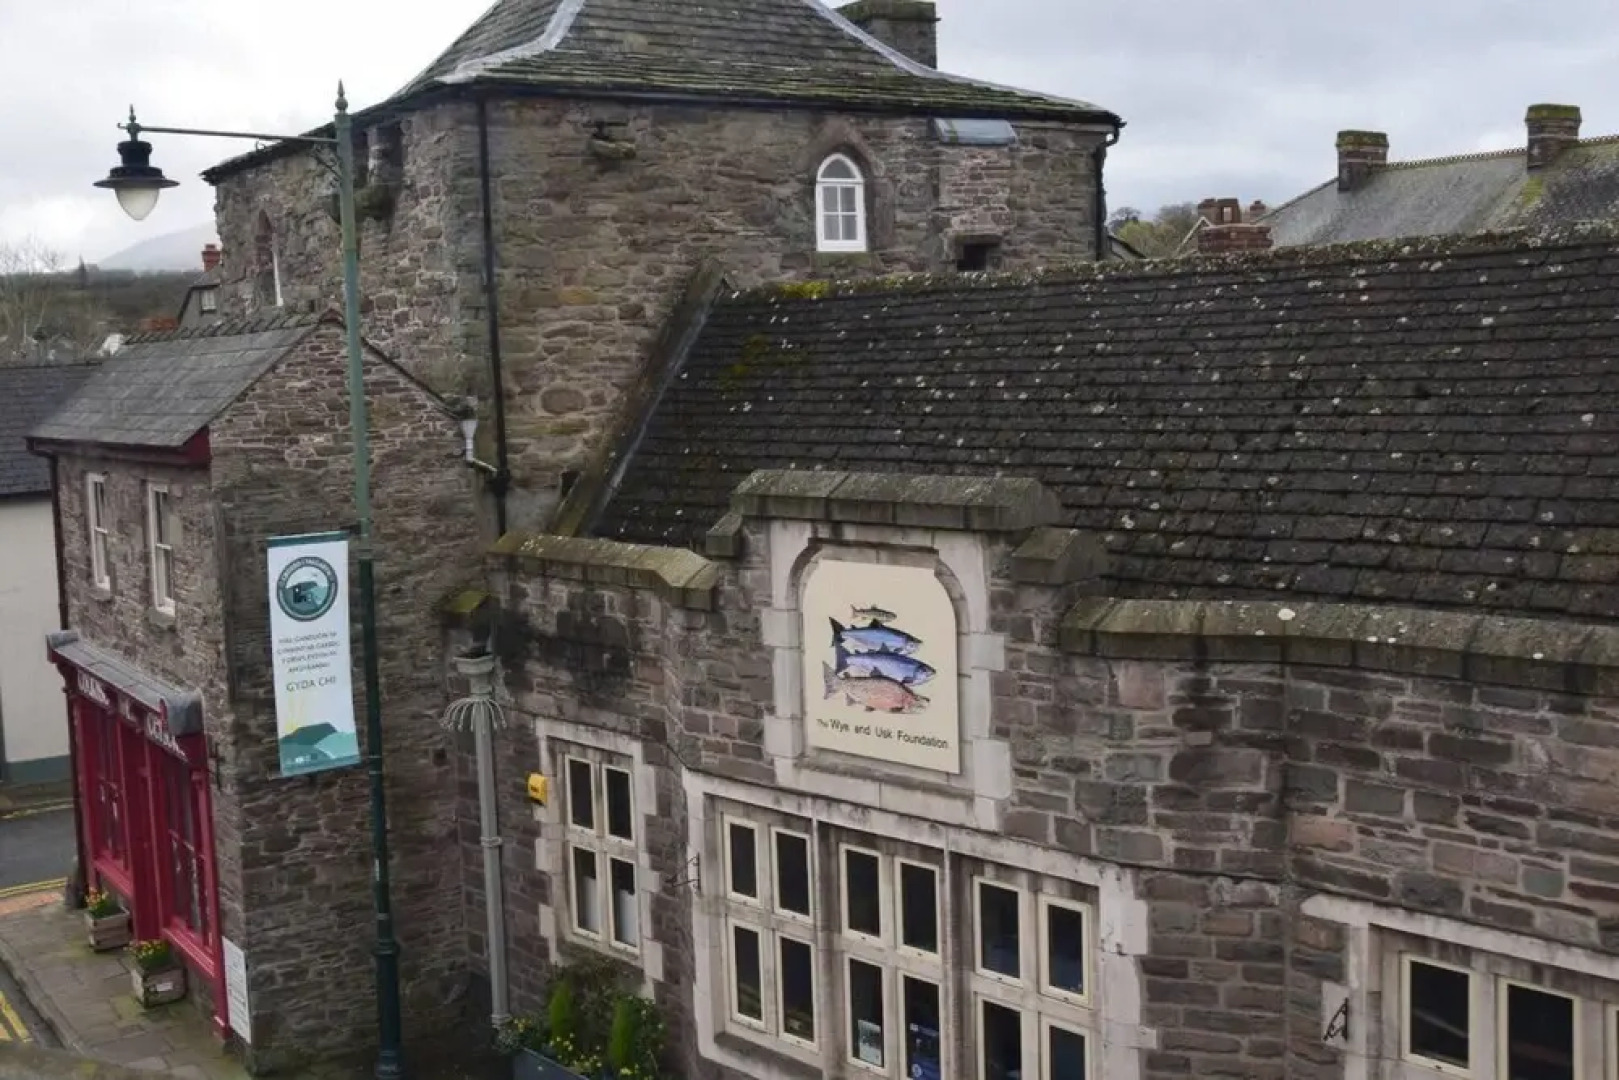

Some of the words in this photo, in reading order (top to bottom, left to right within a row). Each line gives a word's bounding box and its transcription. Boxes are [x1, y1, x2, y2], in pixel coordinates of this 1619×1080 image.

[286, 679, 316, 692] GYDA
[319, 676, 337, 687] CHI
[830, 718, 850, 732] Wye
[854, 724, 871, 736] and
[875, 726, 892, 739] Usk
[897, 730, 948, 749] Foundation
